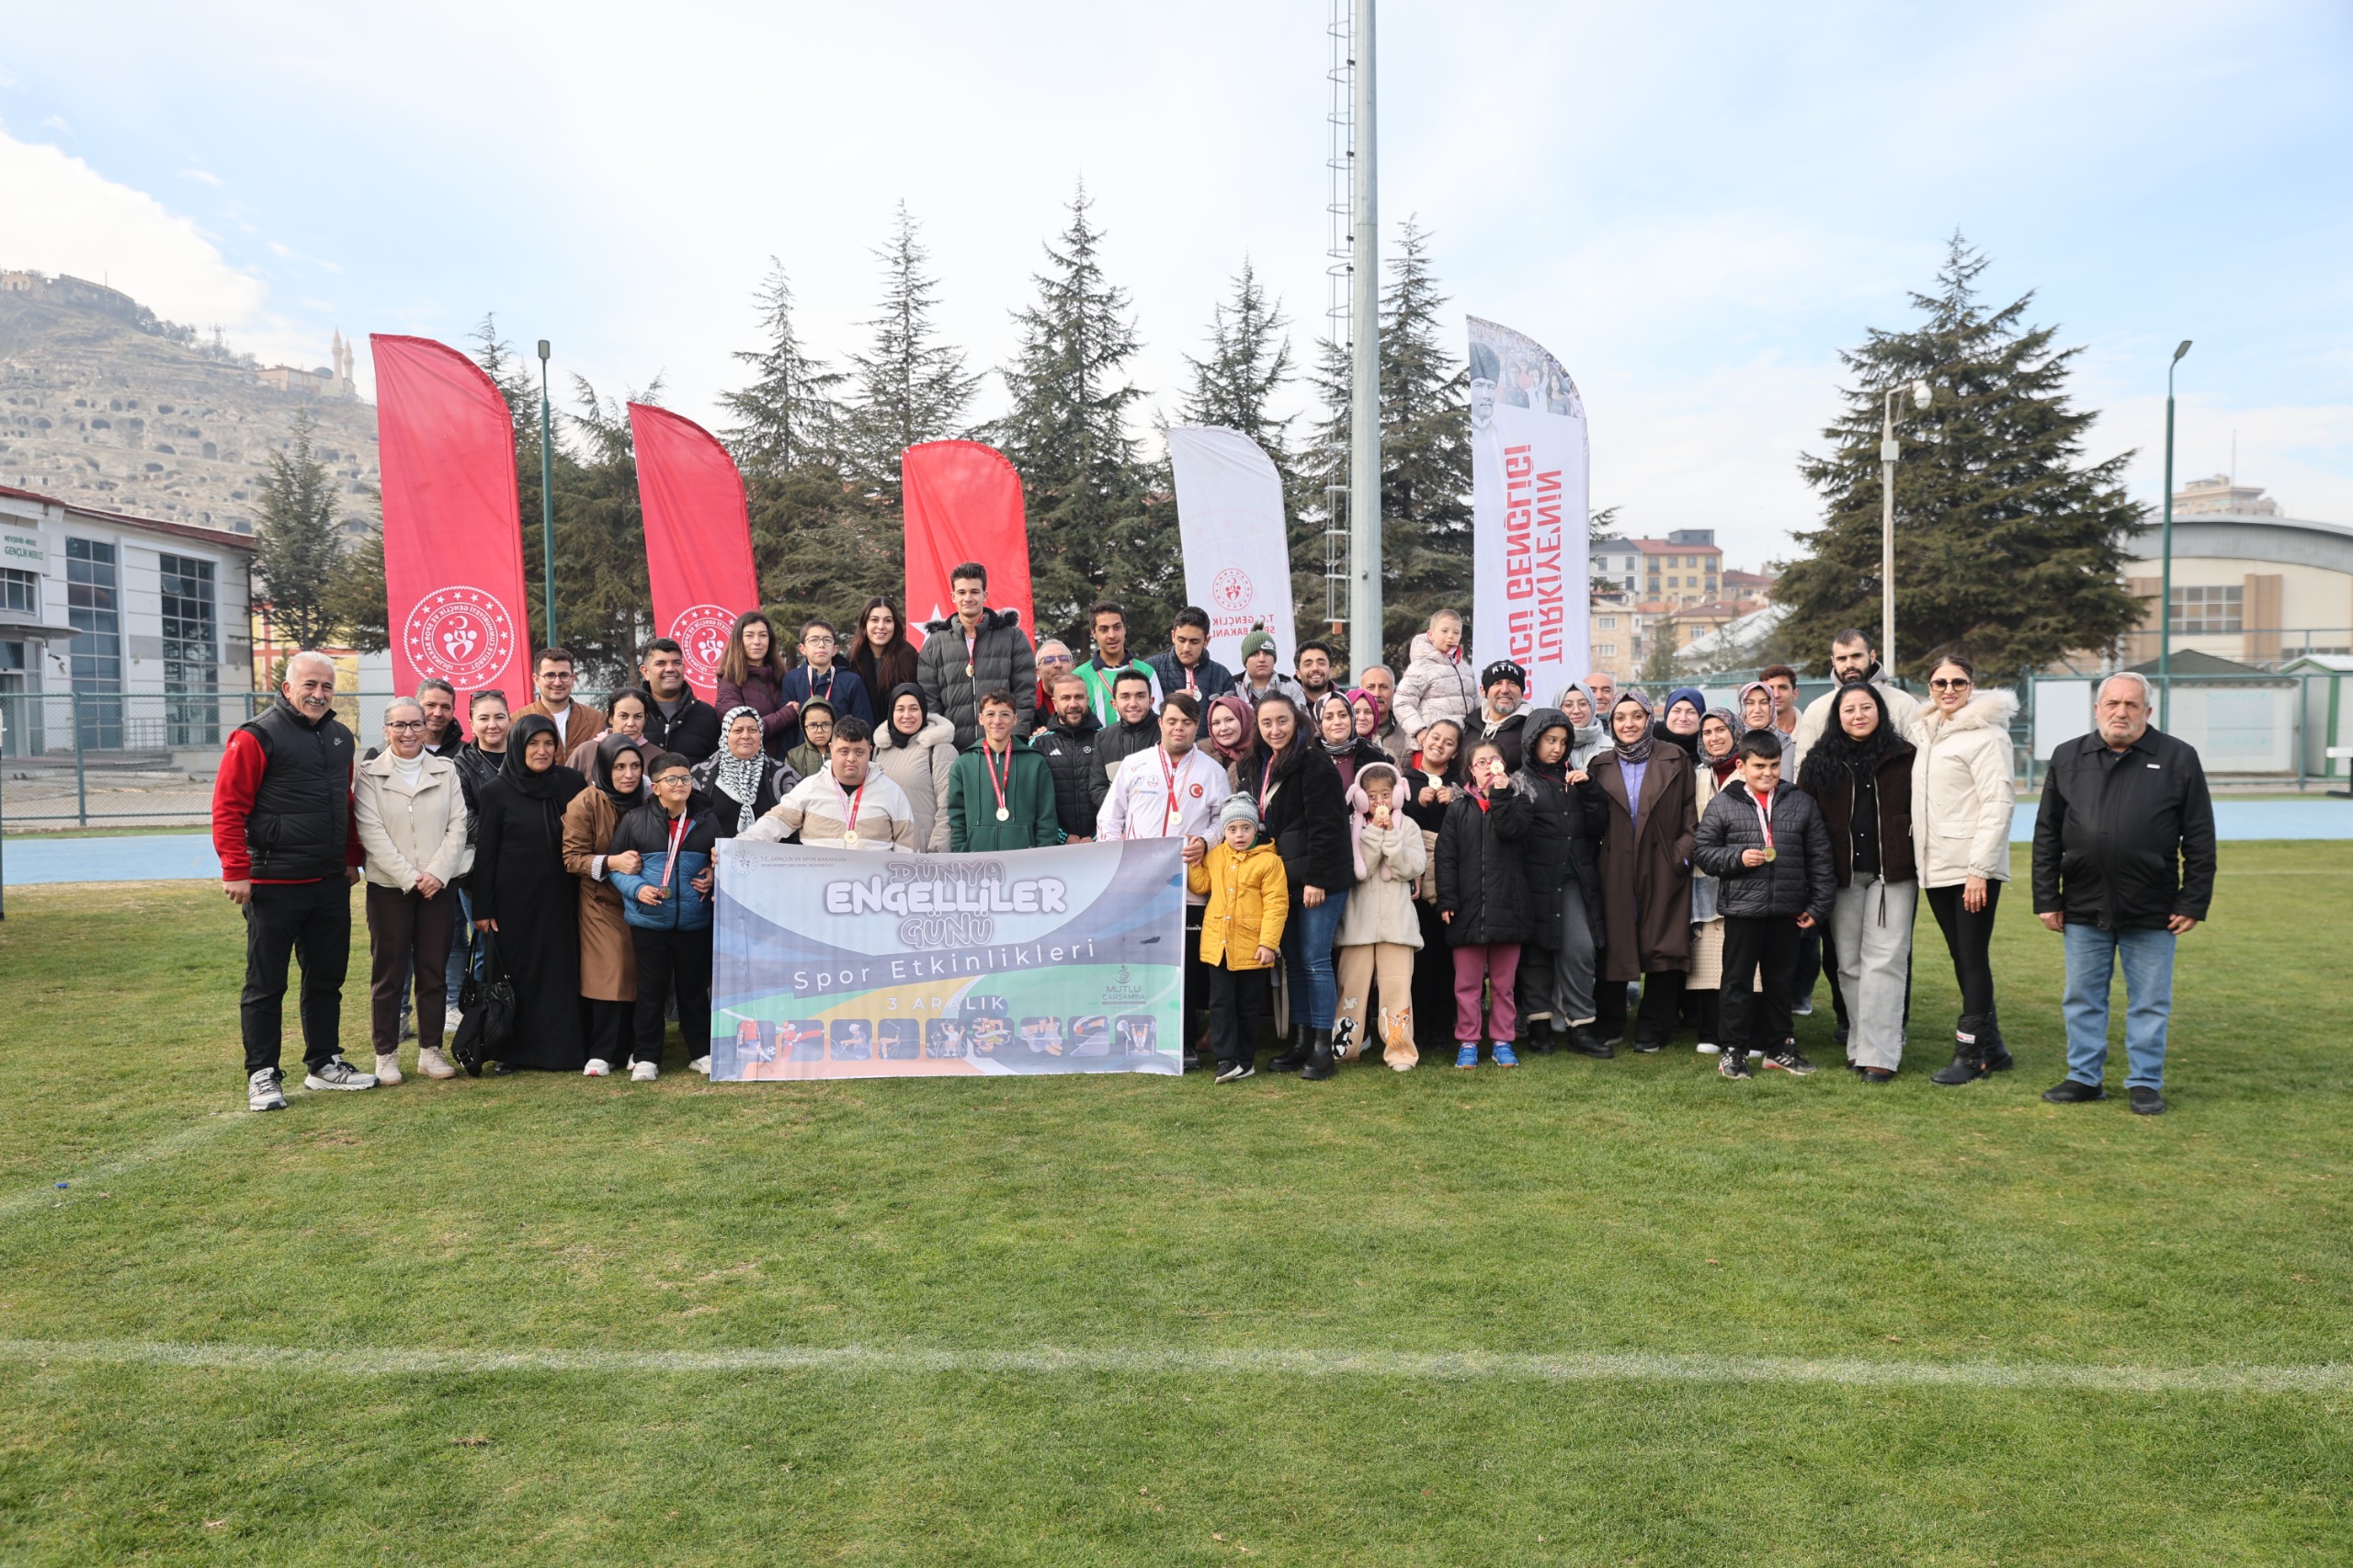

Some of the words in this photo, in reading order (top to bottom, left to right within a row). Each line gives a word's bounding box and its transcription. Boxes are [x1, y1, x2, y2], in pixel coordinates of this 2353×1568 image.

[889, 858, 1006, 887] DÜNYA
[826, 876, 1066, 916] ENGELLİLER
[900, 910, 994, 949] GÜNÜ
[793, 967, 870, 992] Spor
[891, 937, 1095, 980] Etkinlikleri
[887, 997, 898, 1010] 3
[913, 996, 1006, 1010] ARALIK
[1106, 985, 1142, 994] MUTLU
